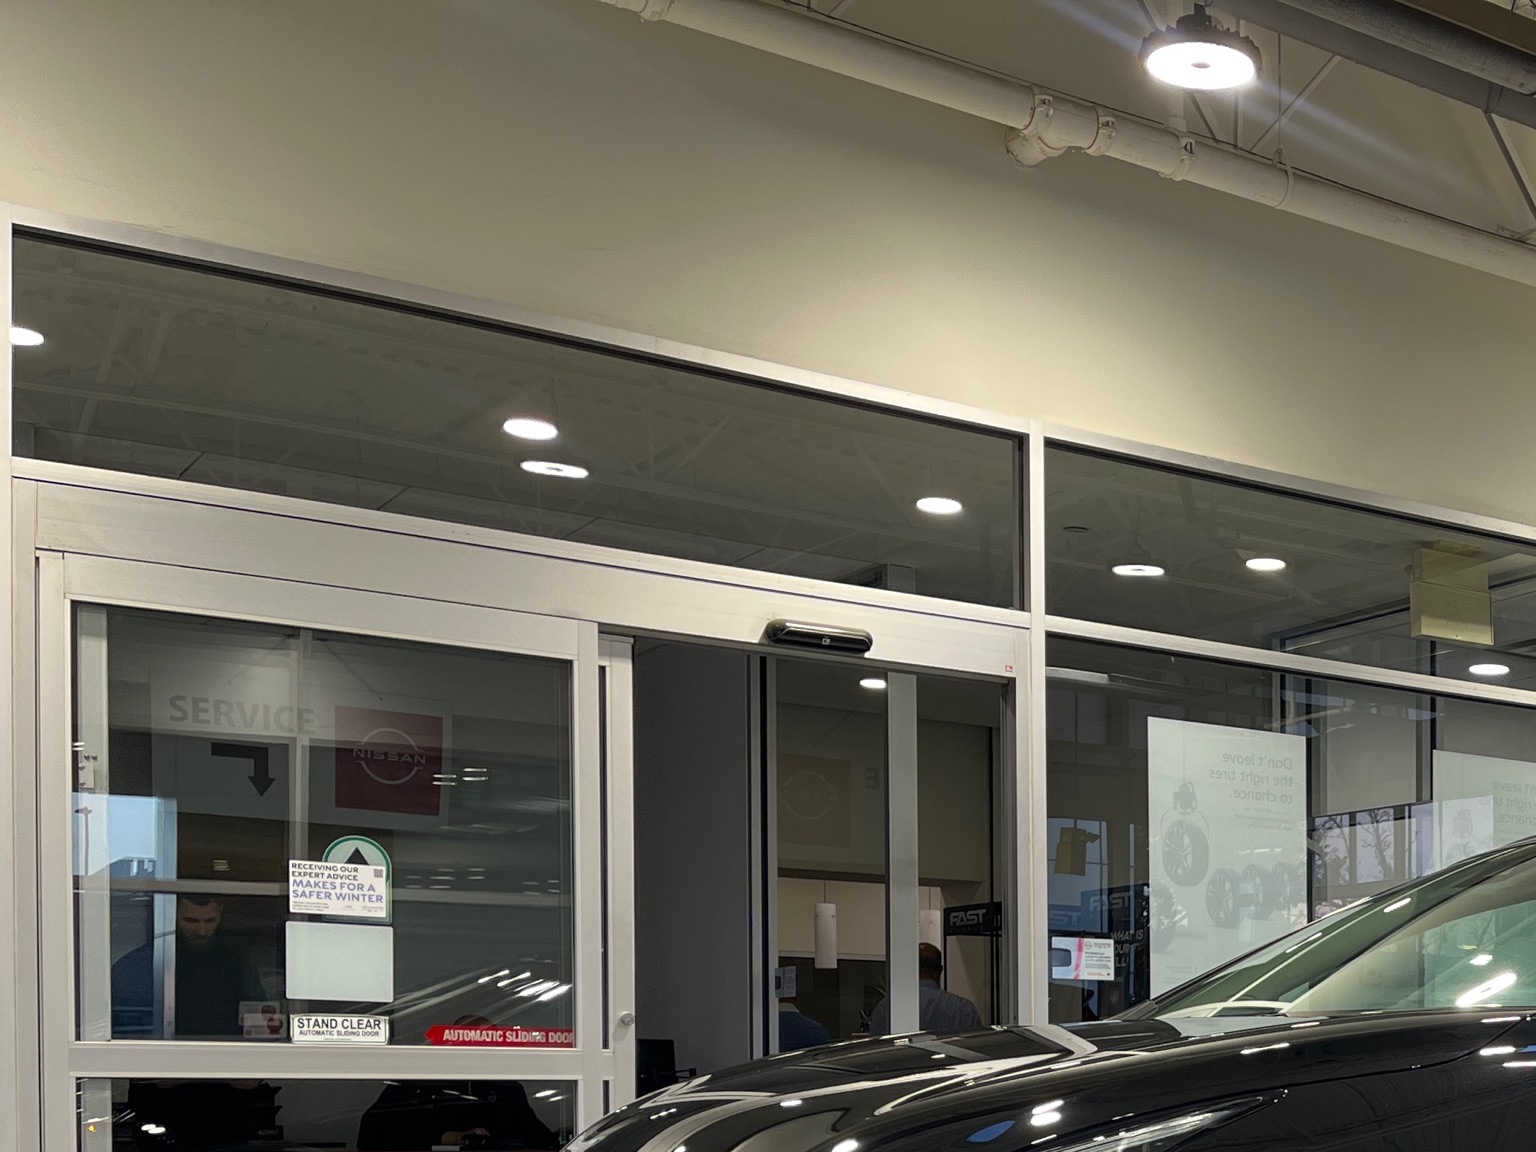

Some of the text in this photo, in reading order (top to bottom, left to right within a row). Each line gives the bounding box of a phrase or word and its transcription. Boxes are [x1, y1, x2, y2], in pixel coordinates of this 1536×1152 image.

[169, 695, 315, 735] SERVICE
[353, 748, 426, 765] NISSAN
[291, 862, 359, 874] RECEIVING OUR
[291, 870, 359, 881] EXPERT ADVICE
[291, 879, 376, 893] MAKES FOR A
[291, 889, 384, 903] SAFER WINTER
[949, 908, 987, 927] FAST
[1110, 929, 1145, 942] WHAT IS
[1114, 943, 1130, 954] OUR
[297, 1017, 382, 1030] STAND CLEAR
[442, 1029, 504, 1042] AUTOMATIC
[505, 1030, 546, 1043] SLIDING
